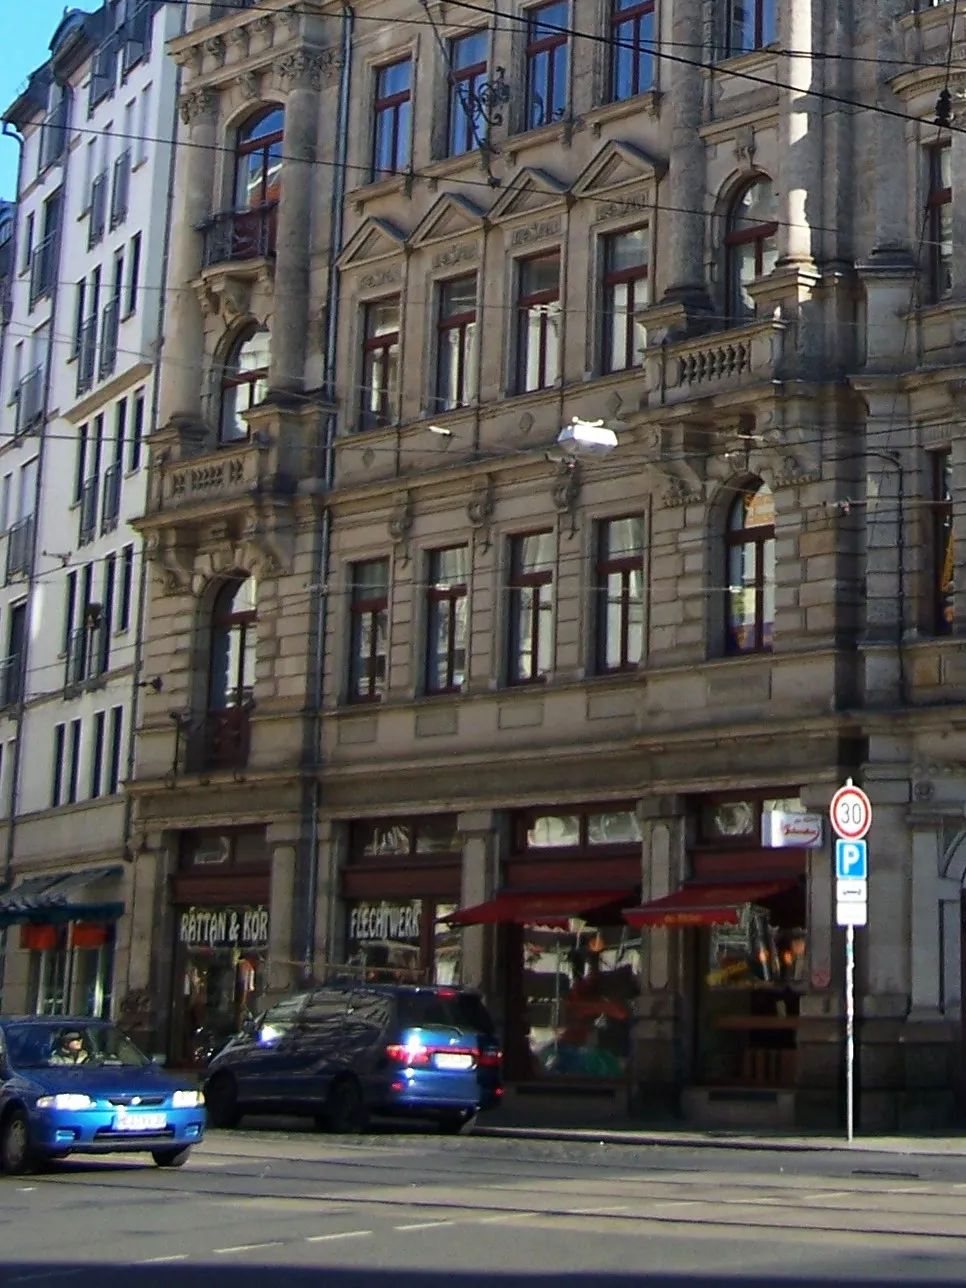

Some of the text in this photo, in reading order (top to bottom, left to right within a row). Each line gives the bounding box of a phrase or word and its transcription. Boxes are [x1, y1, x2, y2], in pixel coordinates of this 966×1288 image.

[841, 802, 862, 824] 30
[843, 845, 860, 873] P
[180, 910, 226, 943] RATTAN
[229, 911, 240, 941] &
